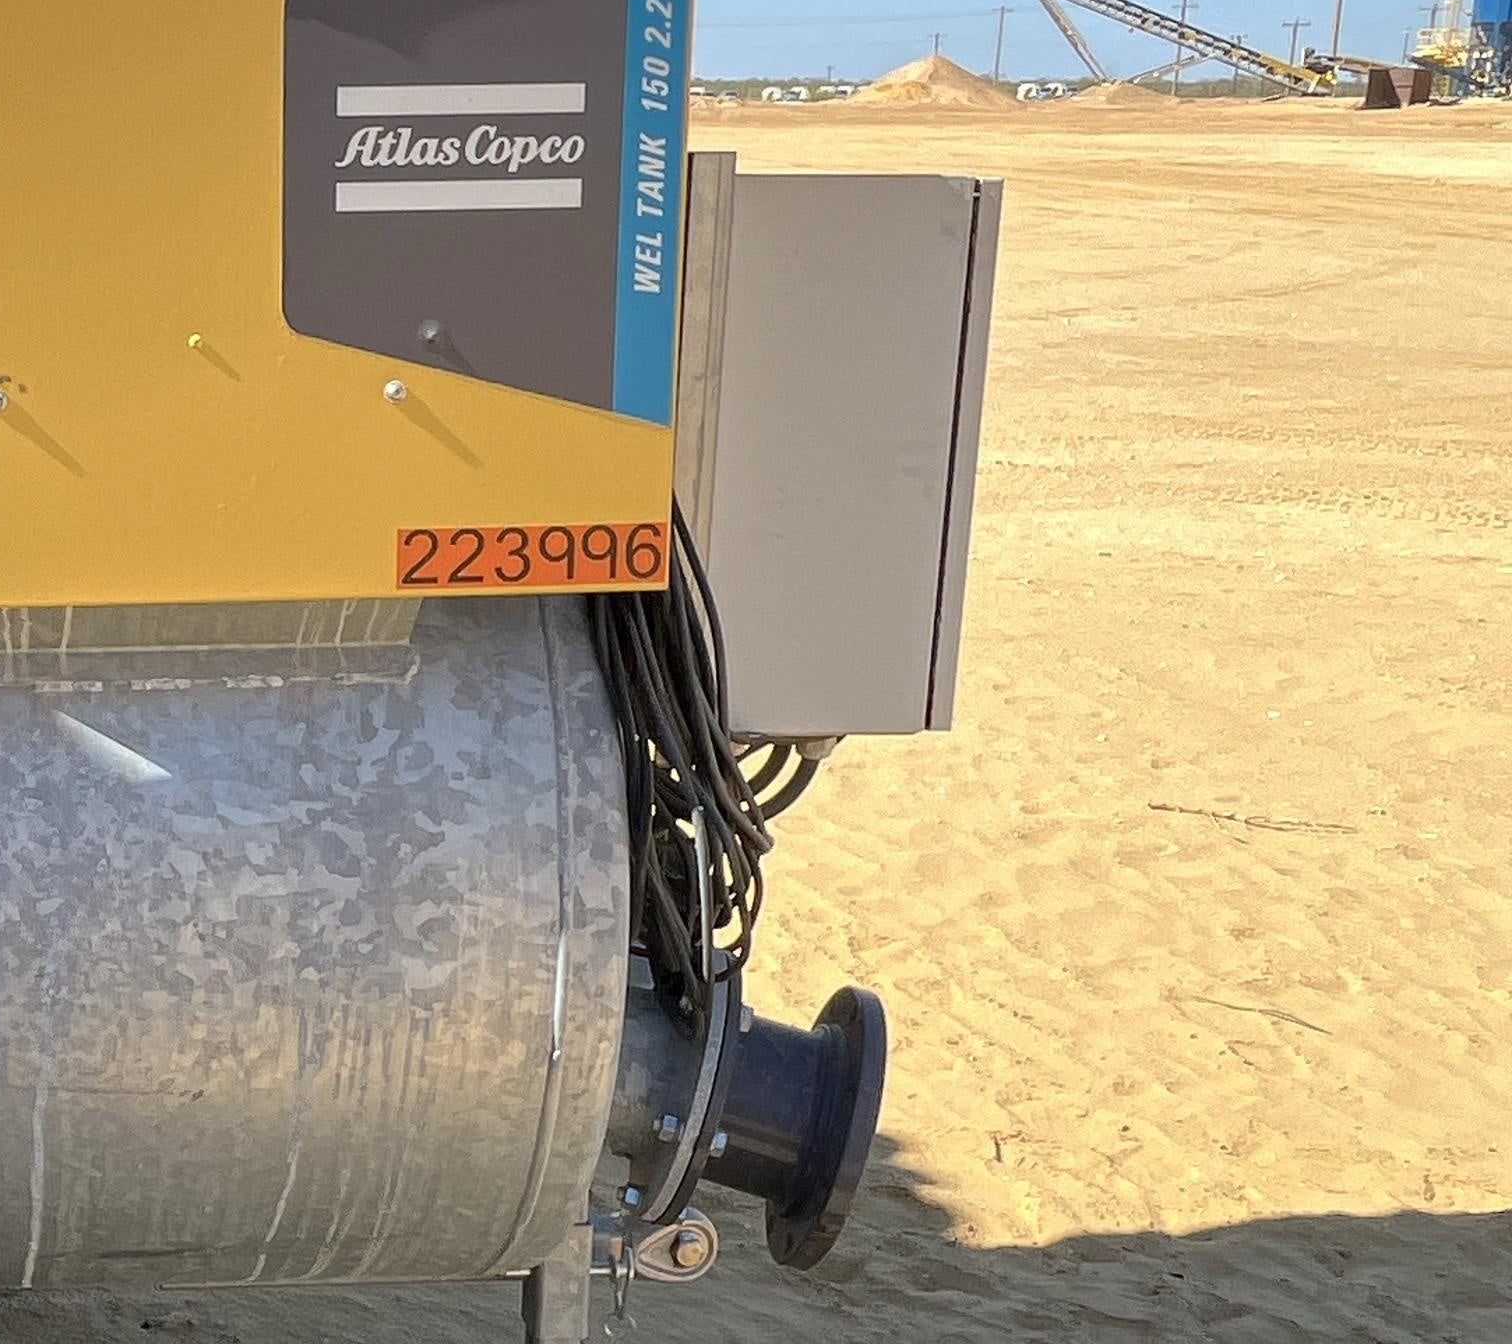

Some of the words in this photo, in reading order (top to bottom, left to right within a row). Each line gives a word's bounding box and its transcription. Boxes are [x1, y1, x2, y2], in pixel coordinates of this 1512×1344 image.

[641, 55, 670, 111] 150
[335, 126, 461, 168] Atlas
[464, 125, 585, 173] Copco
[637, 132, 666, 216] TANK
[633, 232, 662, 294] WEL
[401, 523, 662, 585] 223996
